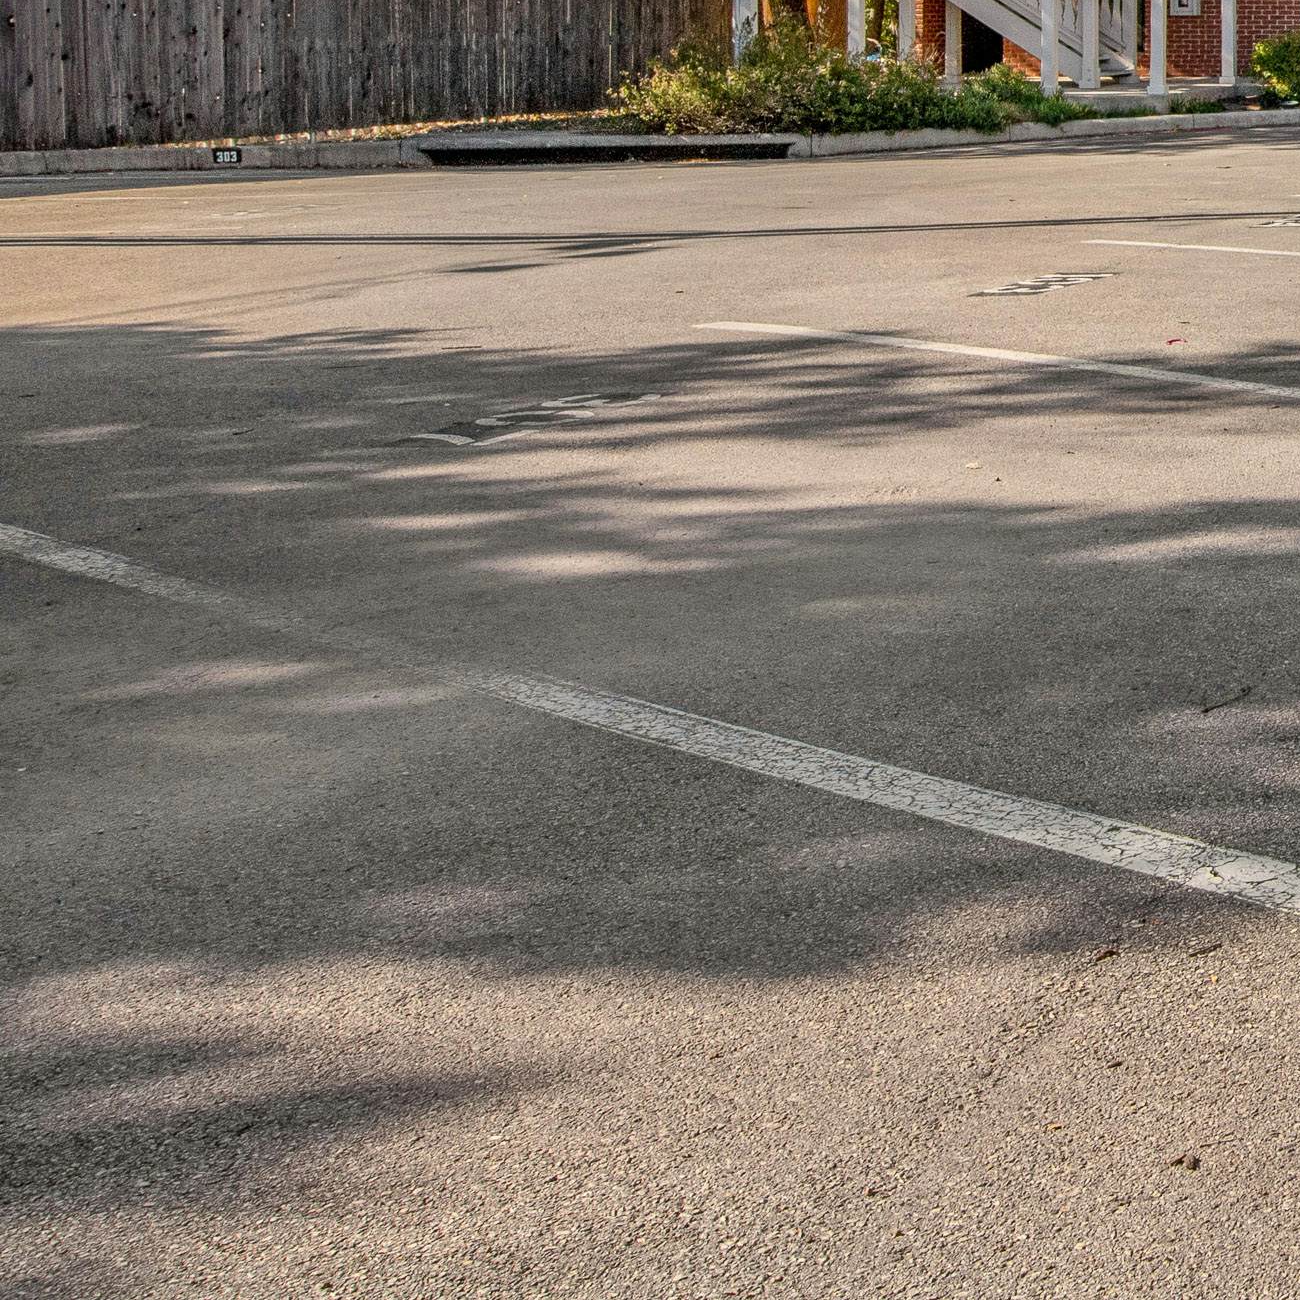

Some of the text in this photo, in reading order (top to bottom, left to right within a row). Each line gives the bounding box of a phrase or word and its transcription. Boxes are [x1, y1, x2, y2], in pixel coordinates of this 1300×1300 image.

[216, 151, 237, 162] 303
[978, 273, 1114, 294] 103
[410, 394, 662, 446] 307
